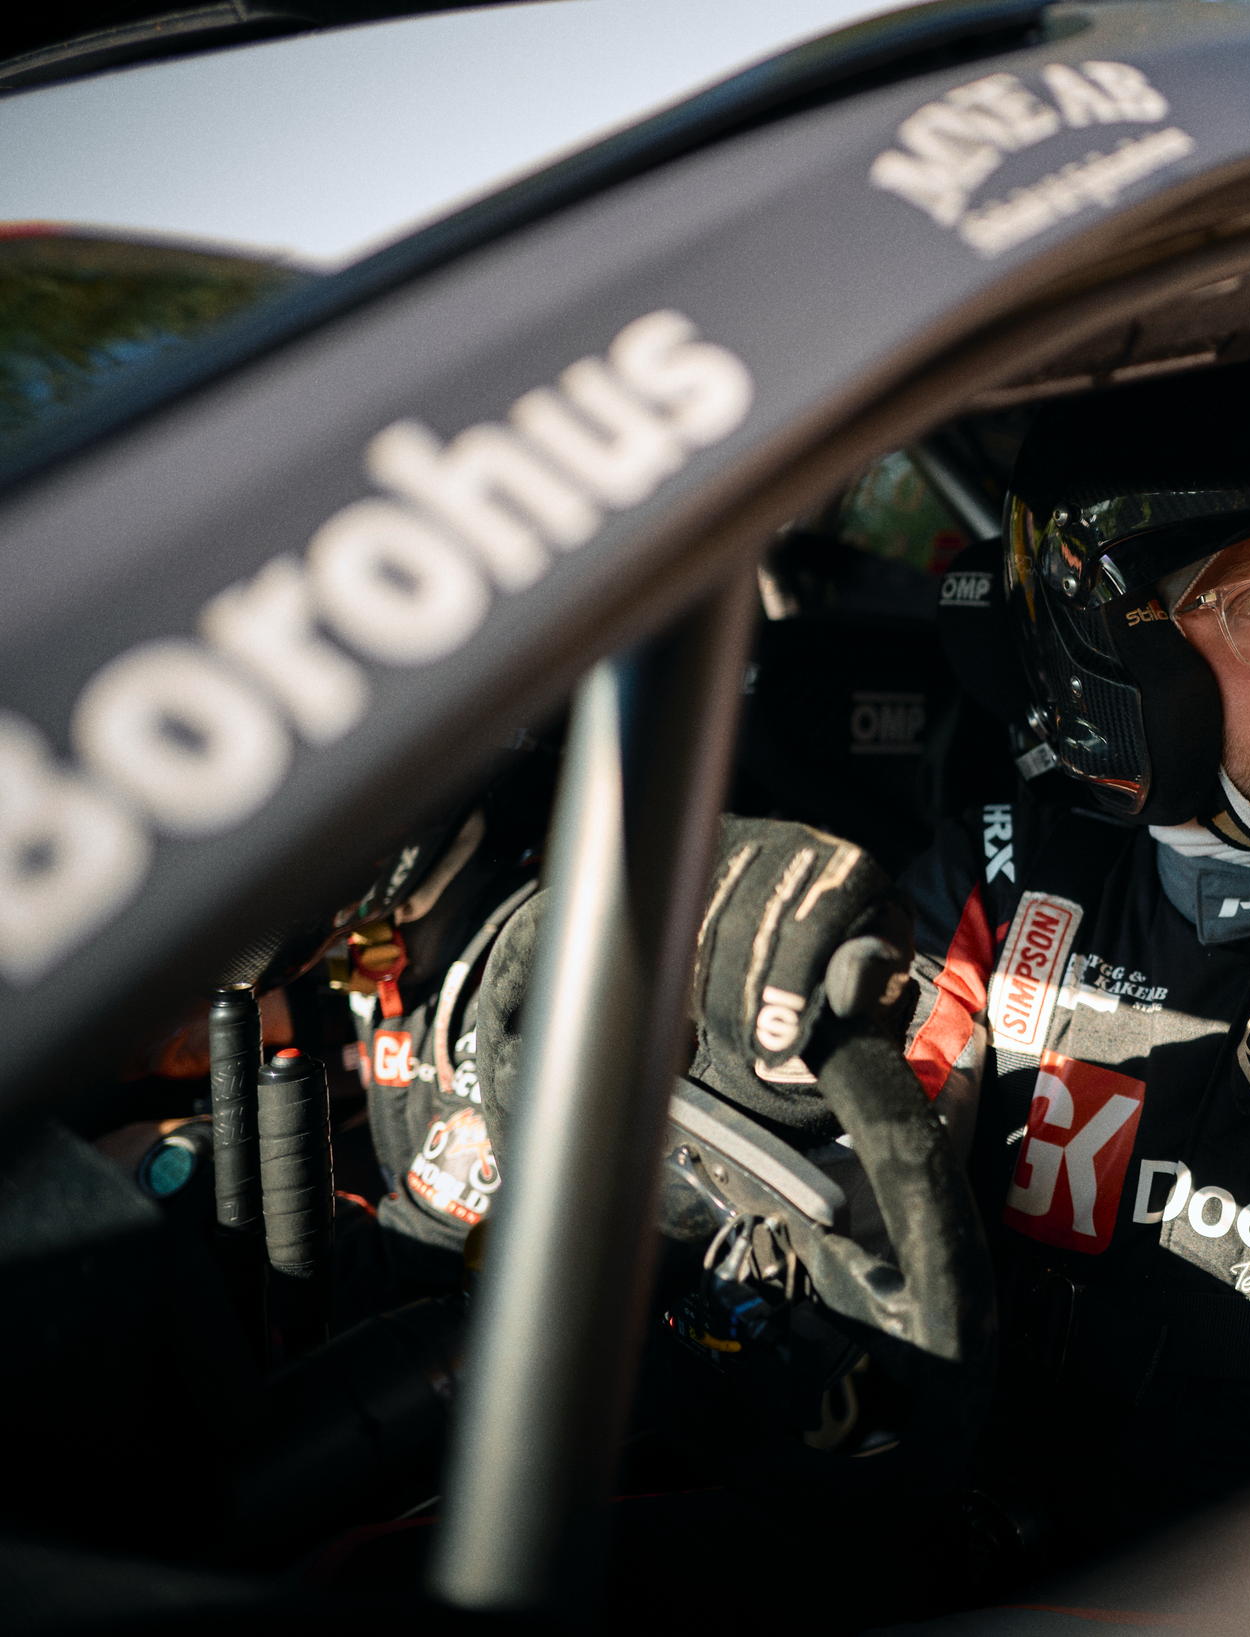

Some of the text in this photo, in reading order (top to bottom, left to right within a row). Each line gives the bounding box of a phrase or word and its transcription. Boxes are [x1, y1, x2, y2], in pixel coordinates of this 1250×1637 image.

[940, 577, 991, 600] OMP
[850, 702, 927, 743] OMP
[982, 803, 1016, 884] HRX
[1003, 912, 1061, 1036] SIMPSON
[1128, 970, 1147, 983] &
[410, 1152, 490, 1215] WORLD
[1006, 1069, 1141, 1238] GK
